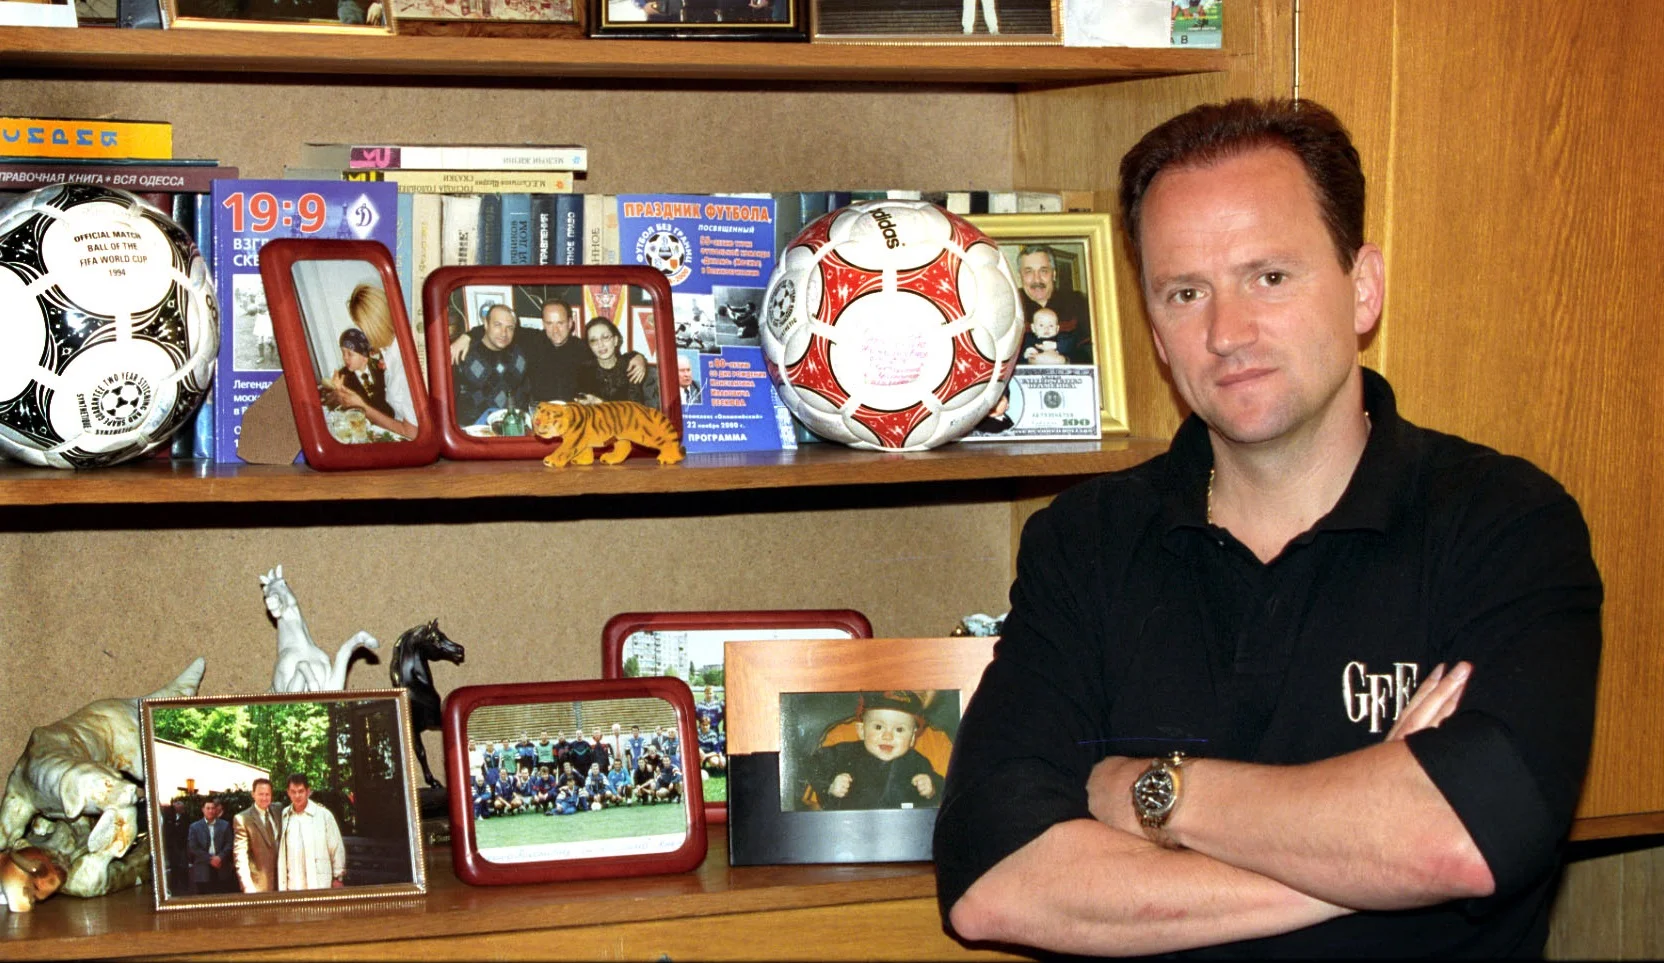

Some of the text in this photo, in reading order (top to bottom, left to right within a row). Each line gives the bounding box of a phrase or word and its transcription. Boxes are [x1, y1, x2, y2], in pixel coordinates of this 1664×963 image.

[69, 173, 103, 184] КНИГА
[113, 175, 136, 185] ВСЯ
[139, 175, 184, 186] ОДЕССА
[440, 185, 474, 193] ГОСПОДА
[223, 192, 327, 233] 19:9
[624, 202, 702, 219] ПРАЗДНИК
[567, 212, 576, 238] ПРАВО
[74, 231, 142, 243] OFFICIAL MATCH
[519, 221, 528, 246] ДОМ
[87, 242, 138, 252] BALL OF THE
[636, 226, 655, 263] ФУТБОЛ
[655, 223, 672, 231] БЕЗ
[79, 255, 148, 268] FIFA WORLD CUP
[109, 268, 126, 276] 1994
[103, 373, 119, 386] TWO
[121, 371, 138, 381] YEAR
[686, 421, 697, 429] 22
[1062, 418, 1091, 426] 100
[688, 433, 748, 442] ПРОГРАММА
[1342, 661, 1418, 733] GFF
